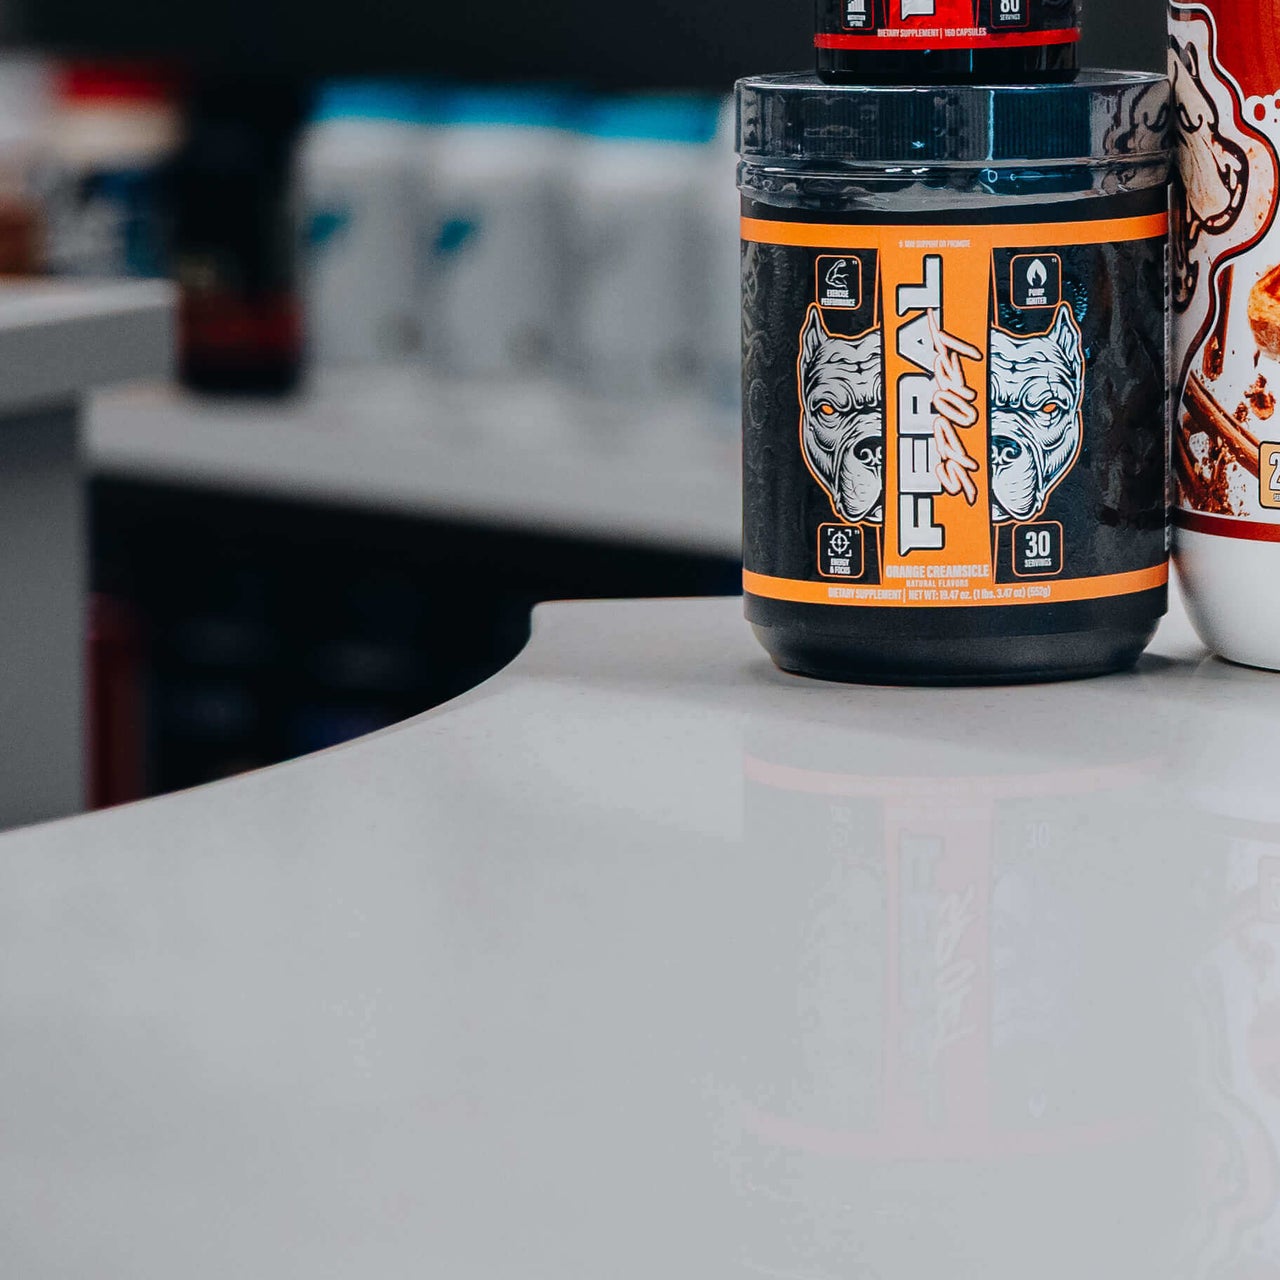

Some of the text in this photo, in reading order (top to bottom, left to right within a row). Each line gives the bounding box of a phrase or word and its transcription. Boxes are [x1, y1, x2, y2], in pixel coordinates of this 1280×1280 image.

[877, 28, 900, 37] DIETARY
[900, 29, 939, 37] SUPPLEMENT
[957, 27, 987, 36] CAPSULES
[899, 257, 943, 556] FERAL
[927, 307, 983, 506] SPORT
[1025, 530, 1051, 558] 30
[1024, 558, 1052, 567] SERVINGS
[886, 564, 989, 578] ORANGE CREAMSICLE
[906, 579, 969, 587] NATURAL FLAVORS
[828, 587, 854, 598] DIETARY
[855, 589, 901, 600] SUPPLEMENT
[908, 589, 922, 600] NET
[924, 589, 939, 600] WT:
